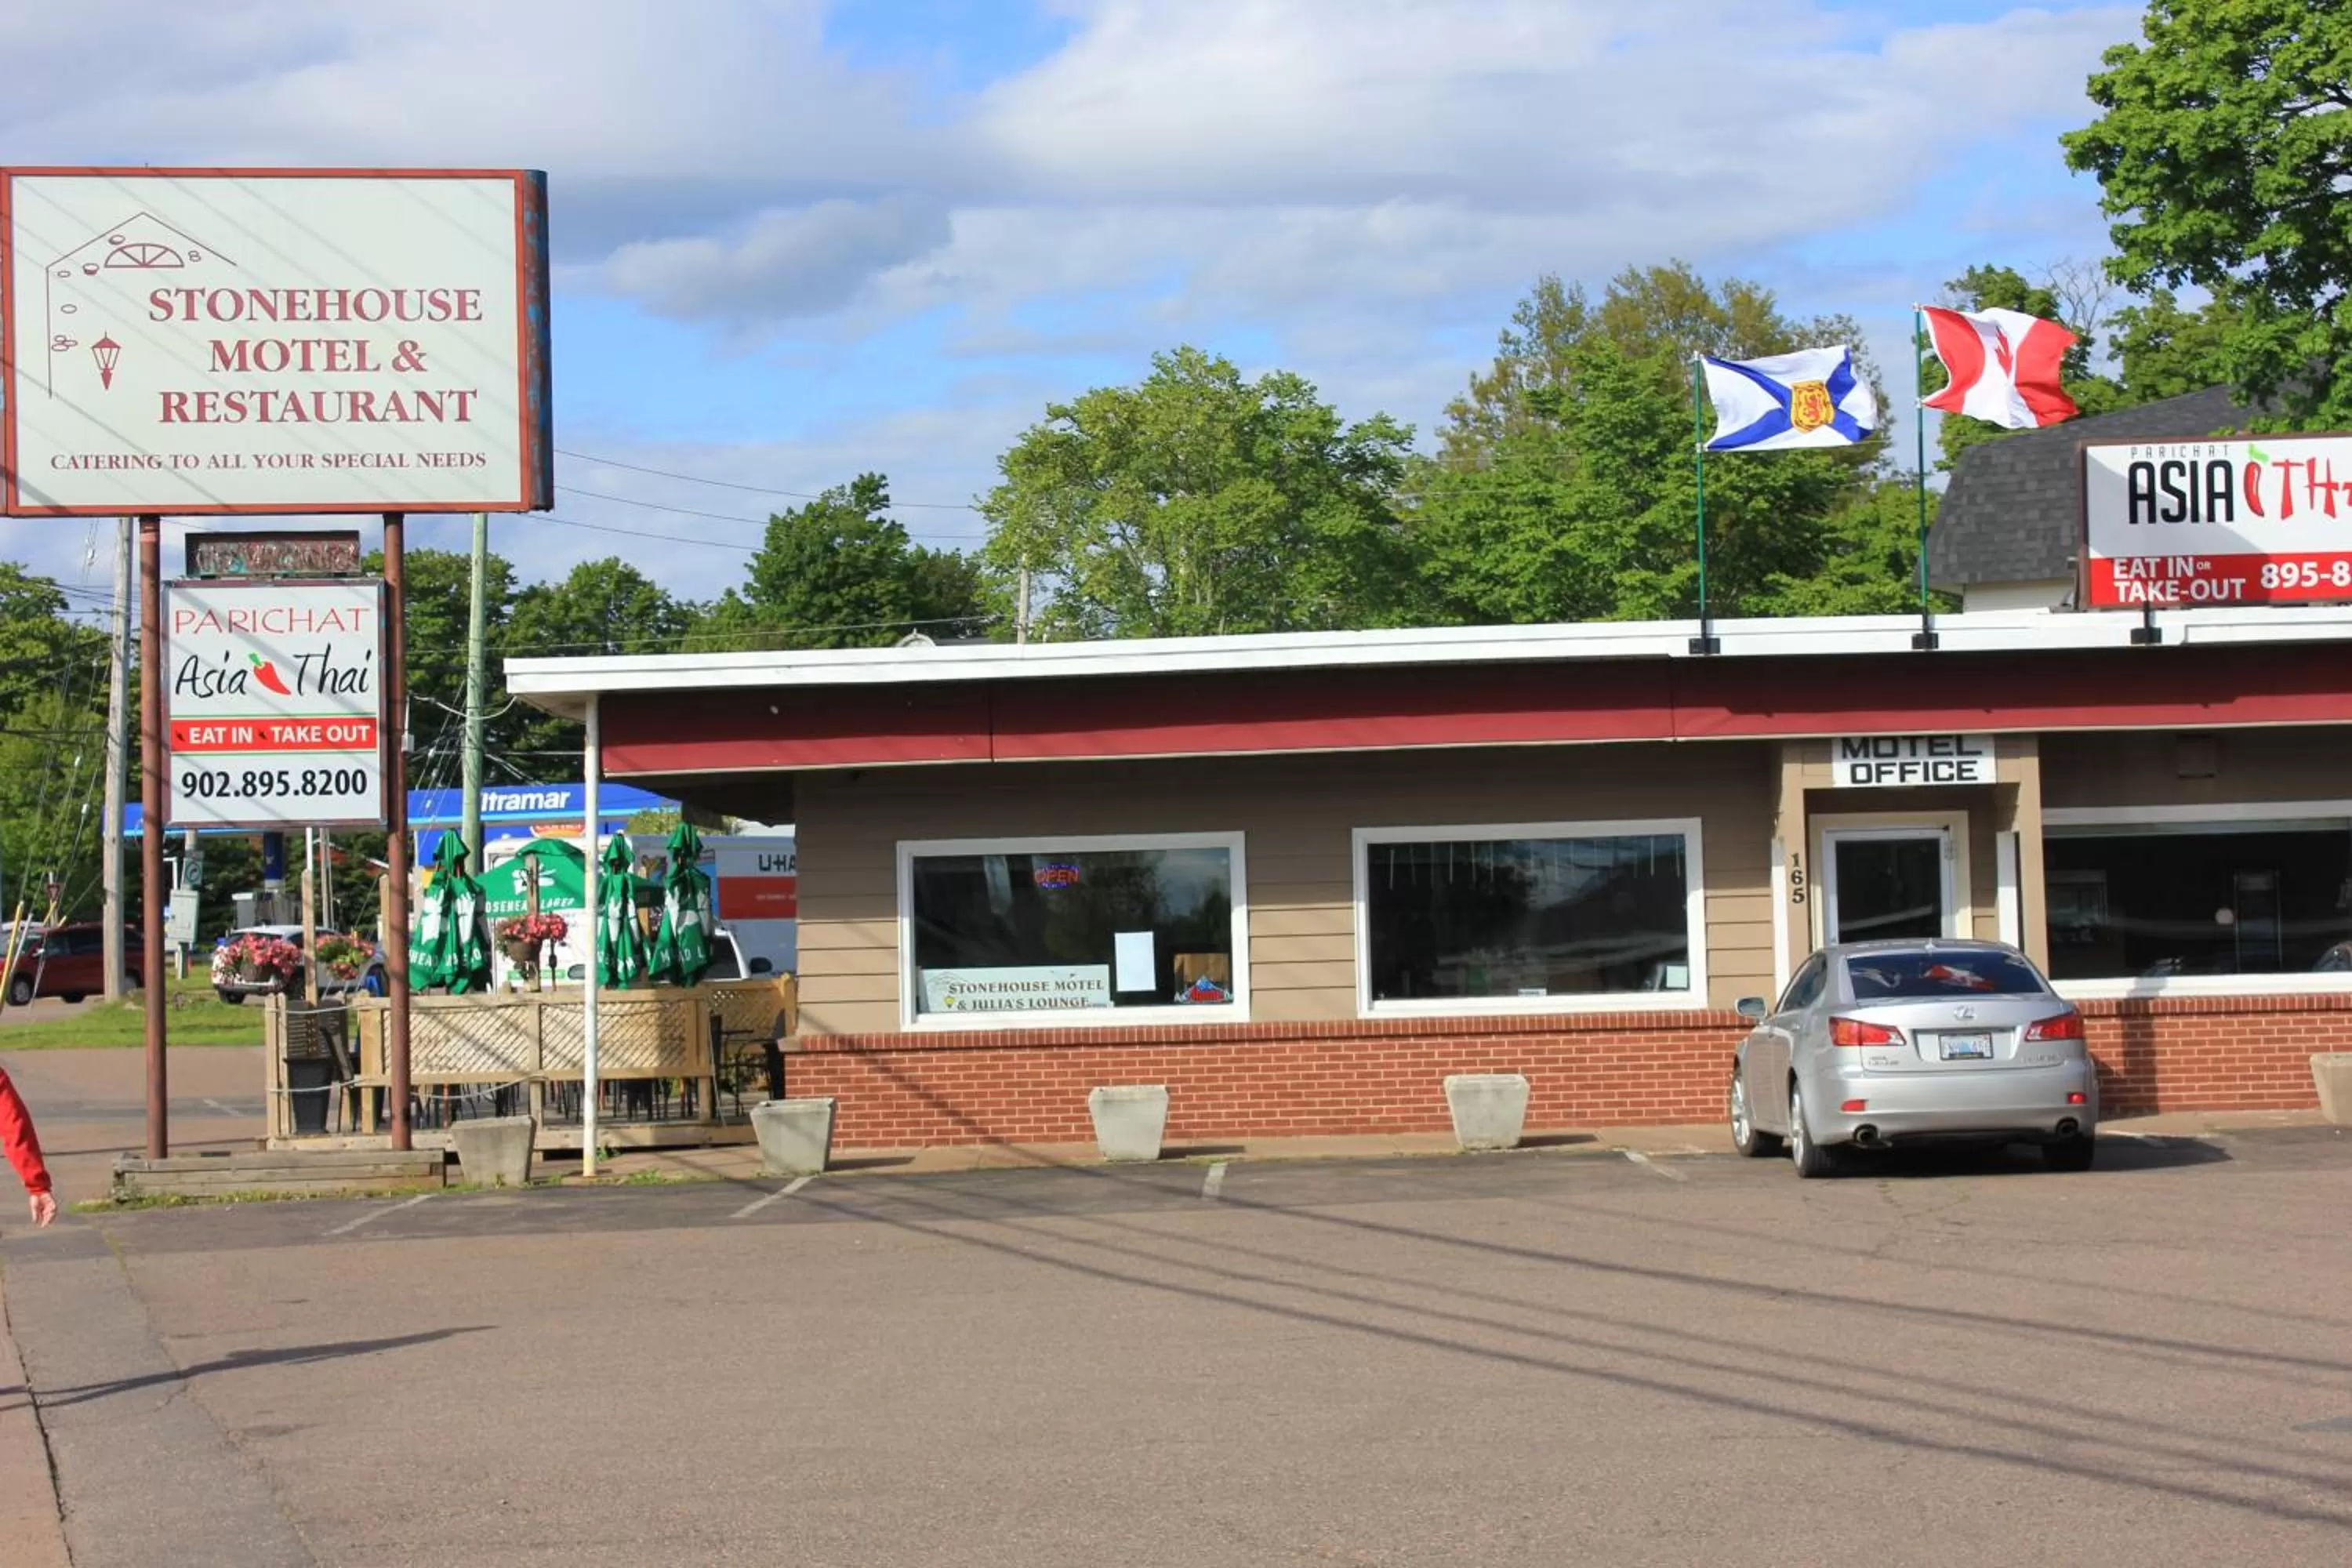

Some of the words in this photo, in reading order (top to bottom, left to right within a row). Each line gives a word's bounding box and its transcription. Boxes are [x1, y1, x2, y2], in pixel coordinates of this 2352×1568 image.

[148, 287, 484, 323] STONEHOUSE
[208, 338, 381, 373] MOTEL
[390, 338, 428, 373] &
[158, 388, 478, 424] RESTAURANT
[50, 453, 163, 470] CATERING
[169, 453, 200, 470] TO
[206, 453, 246, 470] ALL
[252, 453, 314, 470] YOUR
[321, 452, 410, 470] SPECIAL
[416, 452, 487, 469] NEEDS
[2129, 444, 2231, 459] PARICHAT
[2128, 459, 2234, 524] ASIA
[2113, 557, 2161, 579] EAT
[2167, 556, 2194, 579] IN
[2196, 561, 2212, 572] OR
[2260, 560, 2352, 589] 895-8
[2113, 578, 2246, 603] TAKE-OUT
[174, 607, 371, 634] PARICHAT
[174, 649, 248, 699] Asia
[292, 642, 372, 697] Thai
[188, 727, 227, 745] EAT
[231, 727, 253, 744] IN
[270, 725, 322, 743] TAKE
[326, 724, 370, 742] OUT
[1840, 735, 1983, 759] MOTEL
[181, 768, 368, 798] 902.895.8200
[1850, 760, 1978, 784] OFFICE
[481, 790, 572, 812] ltramar
[758, 853, 797, 872] U-HA
[1034, 866, 1080, 884] OPEN
[1790, 851, 1806, 904] 165
[948, 980, 1050, 994] STONEHOUSE
[1054, 979, 1104, 992] MOTEL
[956, 1000, 967, 1011] &
[971, 997, 1025, 1011] JULIA'S
[1029, 996, 1091, 1009] LOUNGE
